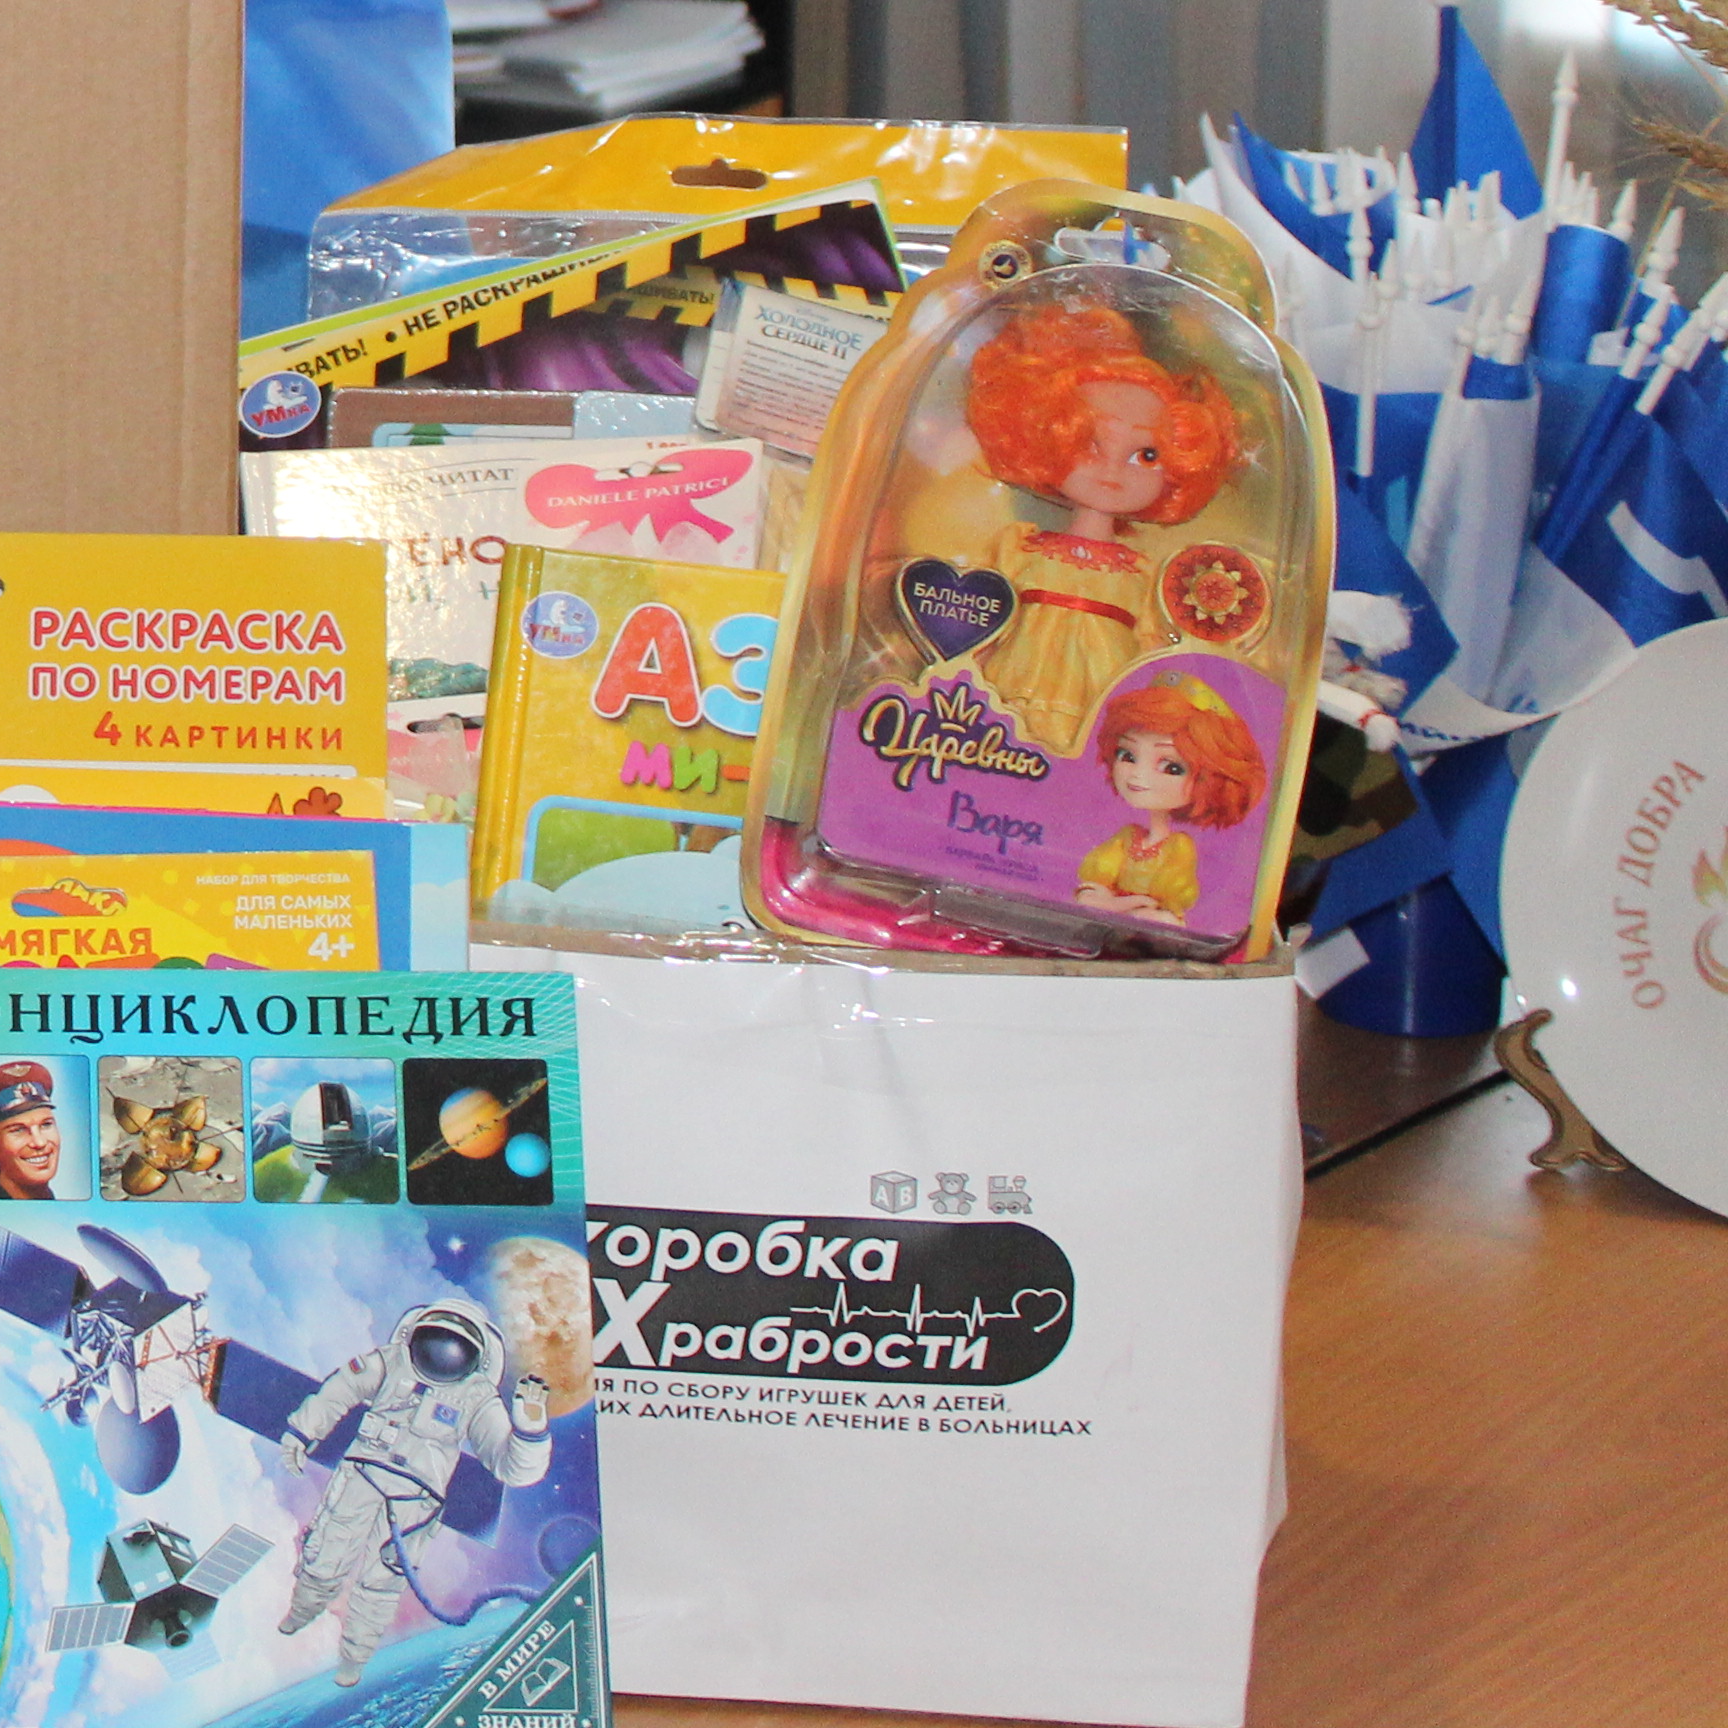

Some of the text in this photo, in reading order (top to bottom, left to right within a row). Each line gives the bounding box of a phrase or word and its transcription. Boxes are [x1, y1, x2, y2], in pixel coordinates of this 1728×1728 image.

[403, 305, 441, 338] НЕ
[755, 305, 863, 351] ХОЛОДНОЕ
[428, 468, 515, 485] ЧИТАТ
[547, 478, 730, 508] DANIELE PATRICI
[914, 582, 1002, 614] БАЛЬНОЕ
[919, 598, 990, 628] ПЛАТЬЕ
[30, 608, 346, 654] РАСКРАСКА
[29, 663, 346, 706] ПО НОМЕРАМ
[93, 710, 344, 751] 4 КАРТИНКИ
[862, 697, 1047, 790] Царевны
[948, 790, 1043, 855] Варя
[196, 874, 350, 886] НАБОР ДЛЯ ТВОРЧЕСТВА
[1613, 760, 1707, 1010] ОЧАГ ДОБРА
[235, 895, 351, 912] ДЛЯ САМЫХ
[234, 914, 353, 930] МАЛЕНЬКИХ
[307, 932, 355, 962] 4+
[592, 1277, 990, 1373] Храбрости
[624, 1380, 658, 1396] ПО
[668, 1382, 751, 1402] СБОРУ
[759, 1386, 868, 1408] ИГРУШЕК
[875, 1392, 925, 1410] ДЛЯ
[638, 1402, 800, 1427] ДЛИТЕЛЬНОЕ
[805, 1410, 910, 1431] ЛЕЧЕНИЕ
[918, 1416, 931, 1432] В
[939, 1417, 1092, 1437] БОЛЬНИЦАХ
[479, 1620, 556, 1699] В МИРЕ
[478, 1713, 577, 1728] ЗНАНИЙ
